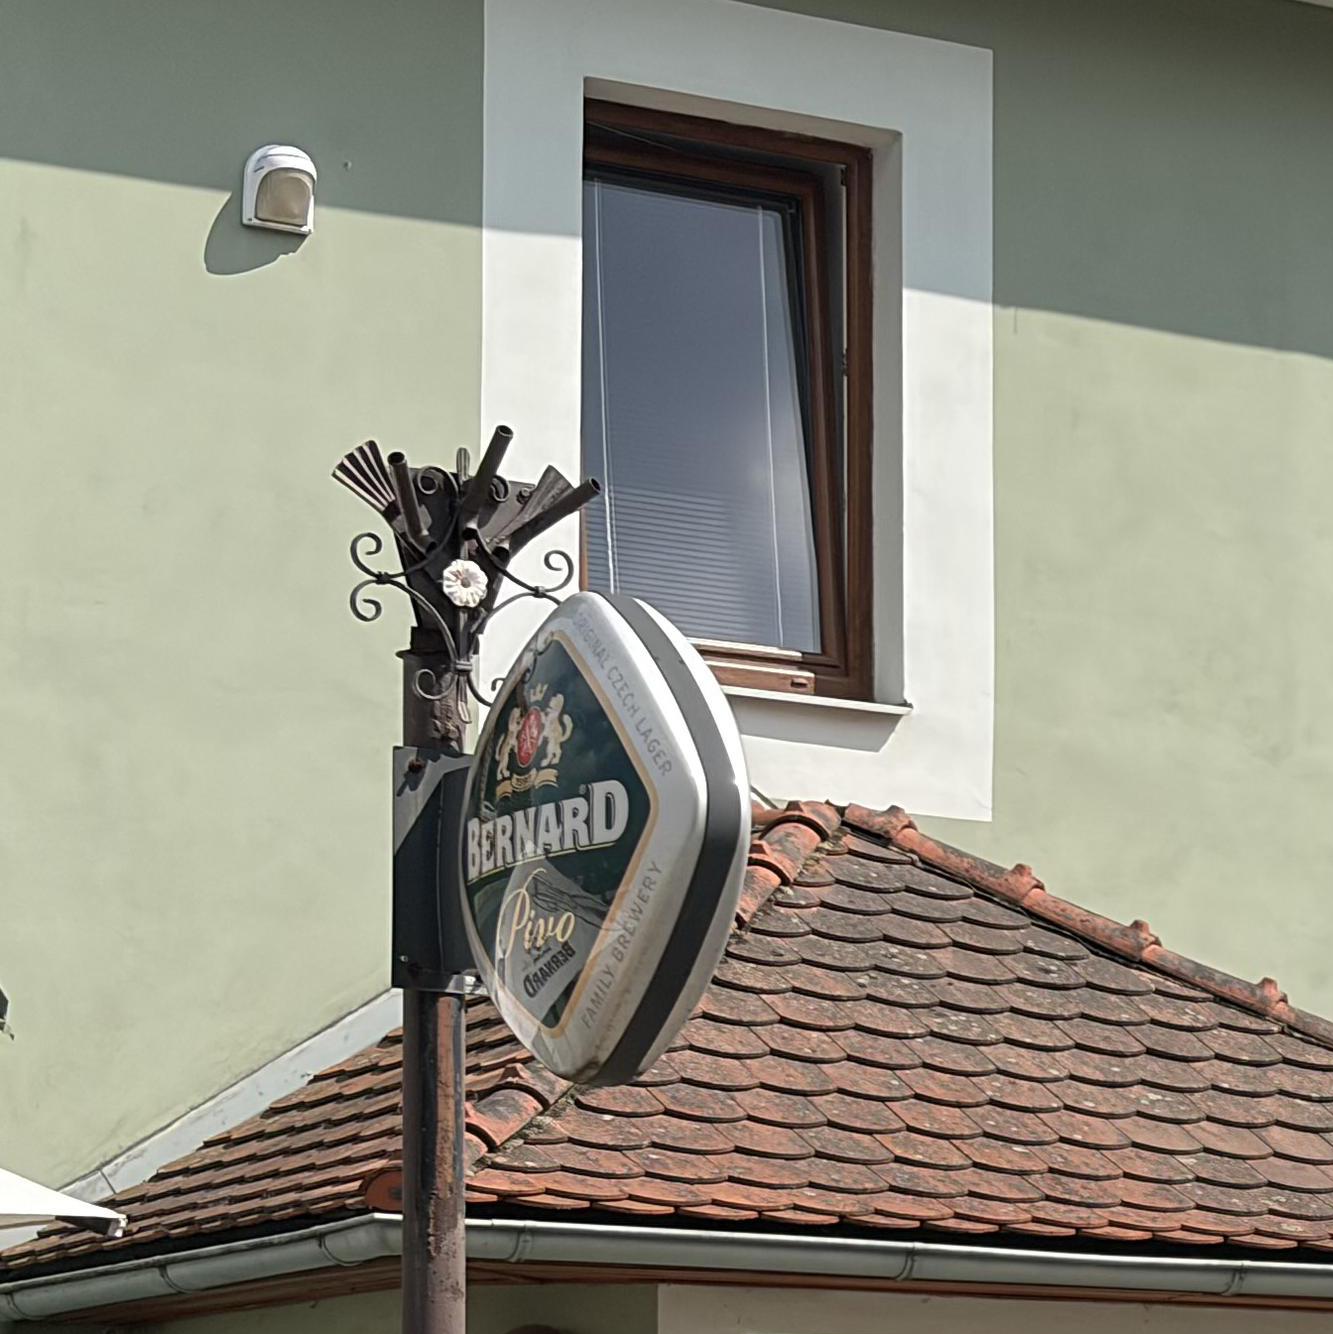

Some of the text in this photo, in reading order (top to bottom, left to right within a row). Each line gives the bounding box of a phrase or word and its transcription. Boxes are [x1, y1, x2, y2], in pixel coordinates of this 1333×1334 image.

[607, 666, 639, 718] CZECH
[635, 716, 672, 777] LAGER
[467, 780, 629, 881] BERNARD
[495, 867, 576, 958] Pivo
[581, 861, 664, 1029] FAMILY BREWERY
